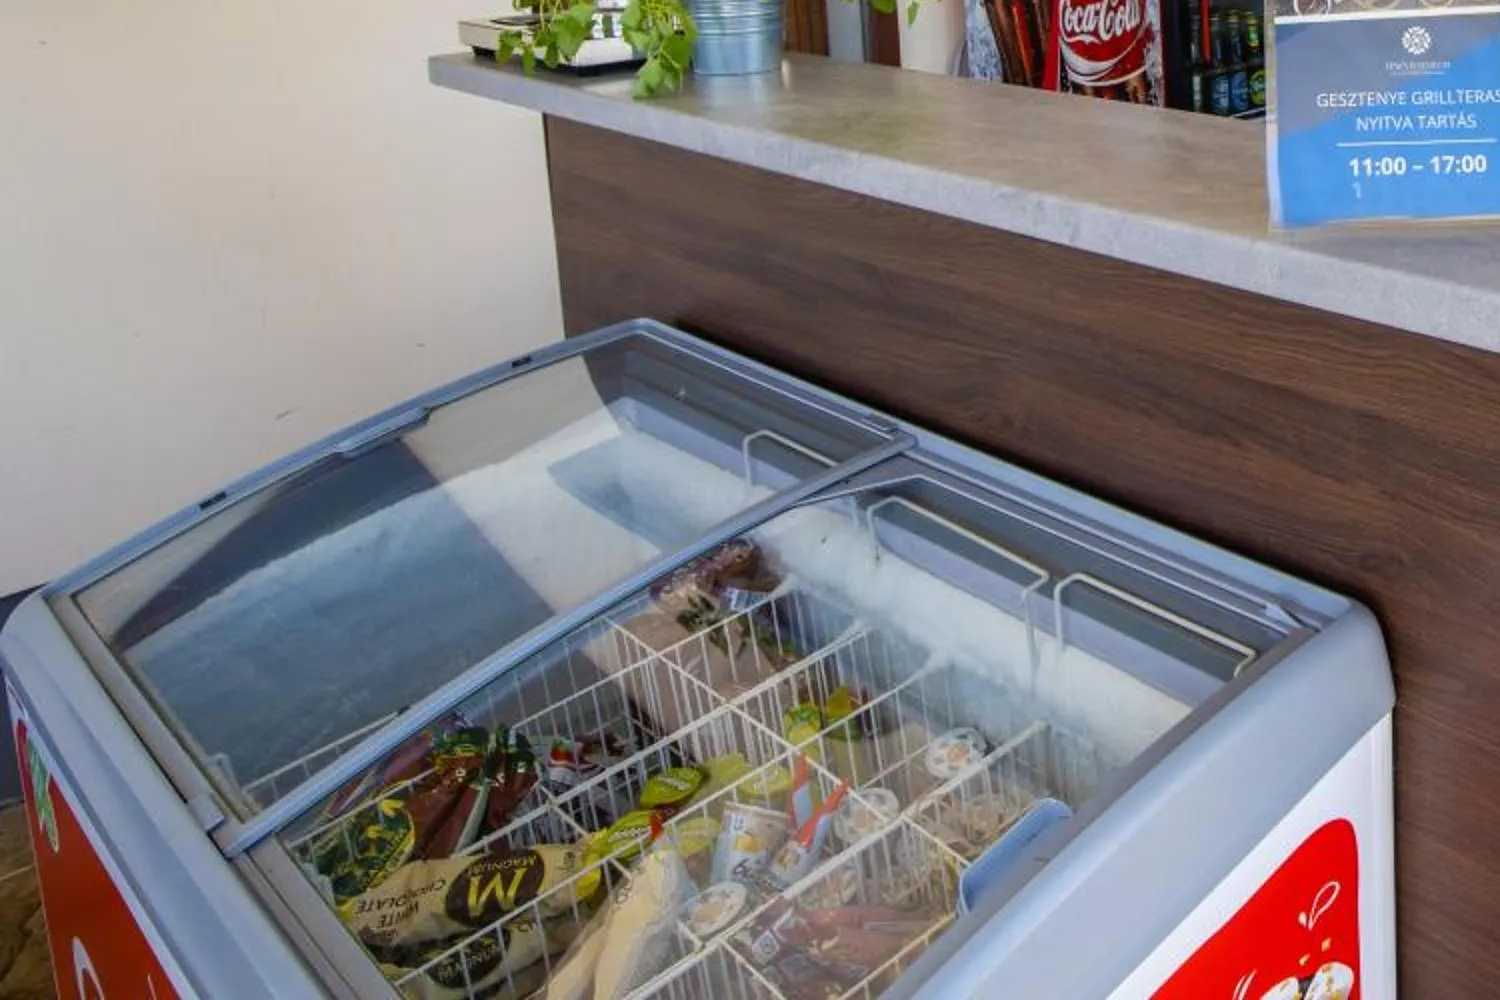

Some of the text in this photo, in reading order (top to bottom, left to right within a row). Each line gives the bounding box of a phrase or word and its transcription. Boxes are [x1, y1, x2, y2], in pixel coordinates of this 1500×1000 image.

[1316, 90, 1407, 107] GESZTENYE
[1356, 112, 1477, 131] NYITVA TARTÁS
[1349, 156, 1407, 177] 11:00
[1429, 154, 1488, 174] 17:00
